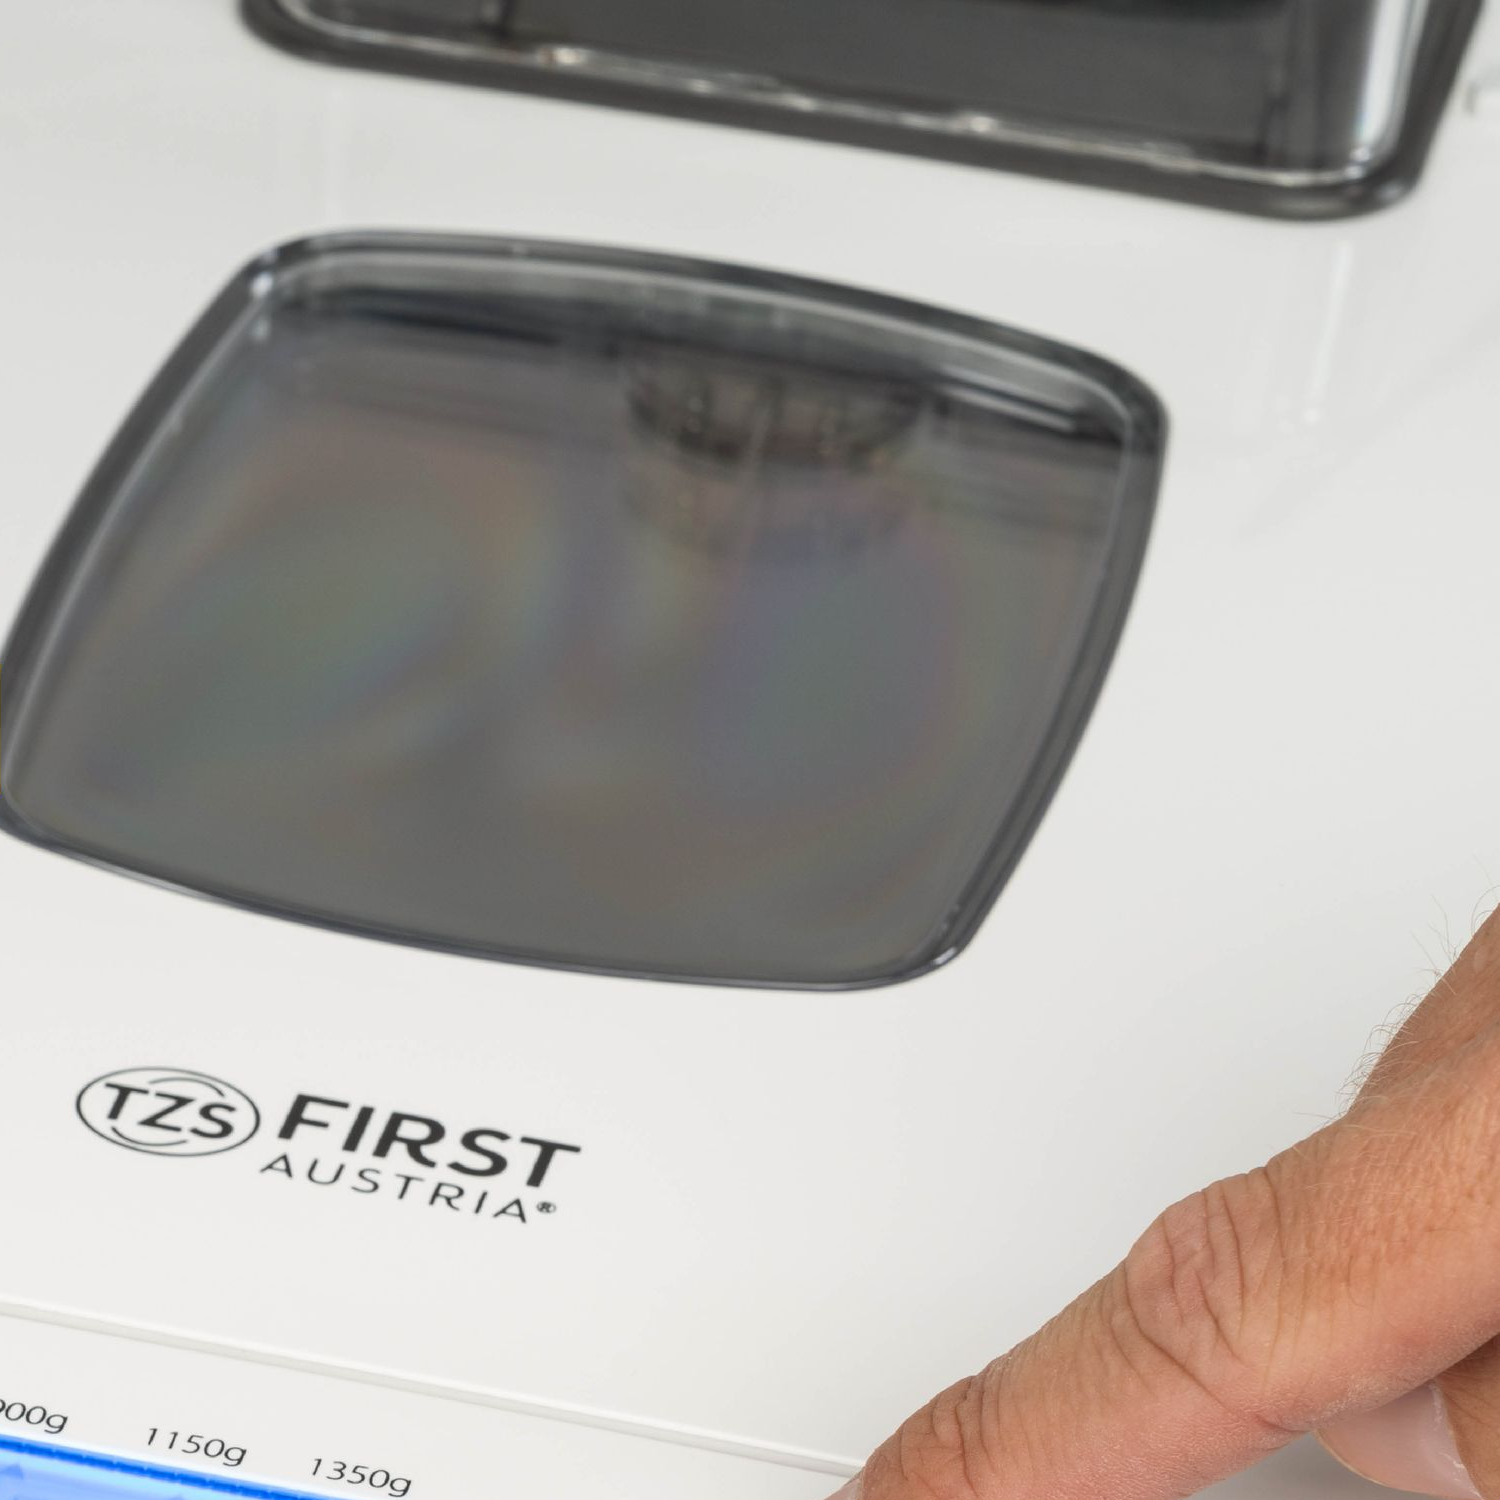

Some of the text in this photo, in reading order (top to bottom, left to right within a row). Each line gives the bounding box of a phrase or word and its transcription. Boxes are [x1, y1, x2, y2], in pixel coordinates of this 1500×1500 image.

[103, 1081, 581, 1187] TZS FIRST
[147, 1428, 246, 1466] 1150g
[311, 1459, 411, 1497] 1350g
